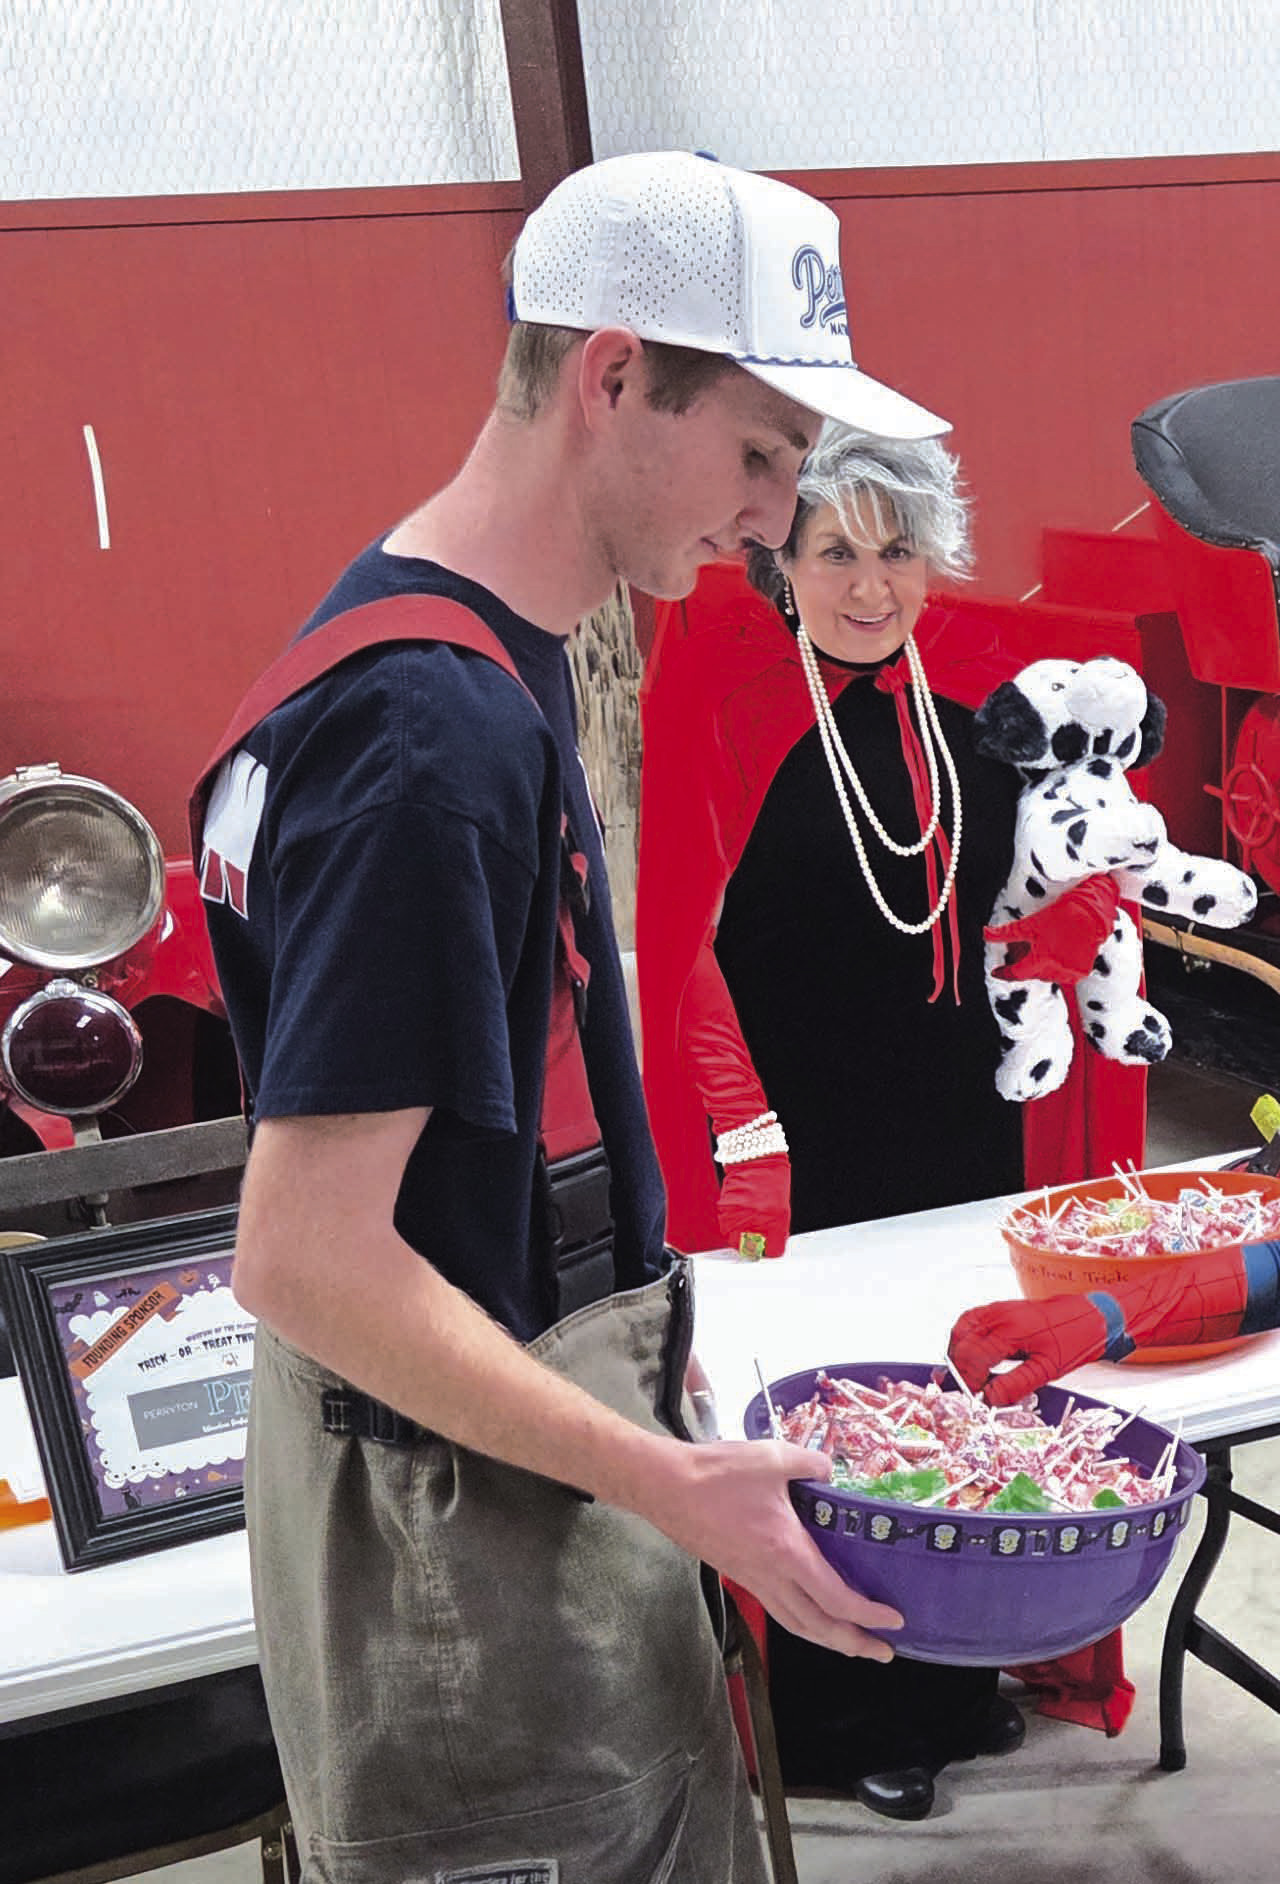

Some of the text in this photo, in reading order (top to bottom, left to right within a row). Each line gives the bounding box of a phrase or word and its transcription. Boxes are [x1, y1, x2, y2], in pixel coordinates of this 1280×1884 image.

[82, 1290, 164, 1368] FOUNDING SPONSOR
[137, 1353, 168, 1373] TRICK
[178, 1345, 192, 1358] OR
[202, 1335, 233, 1350] TREAT
